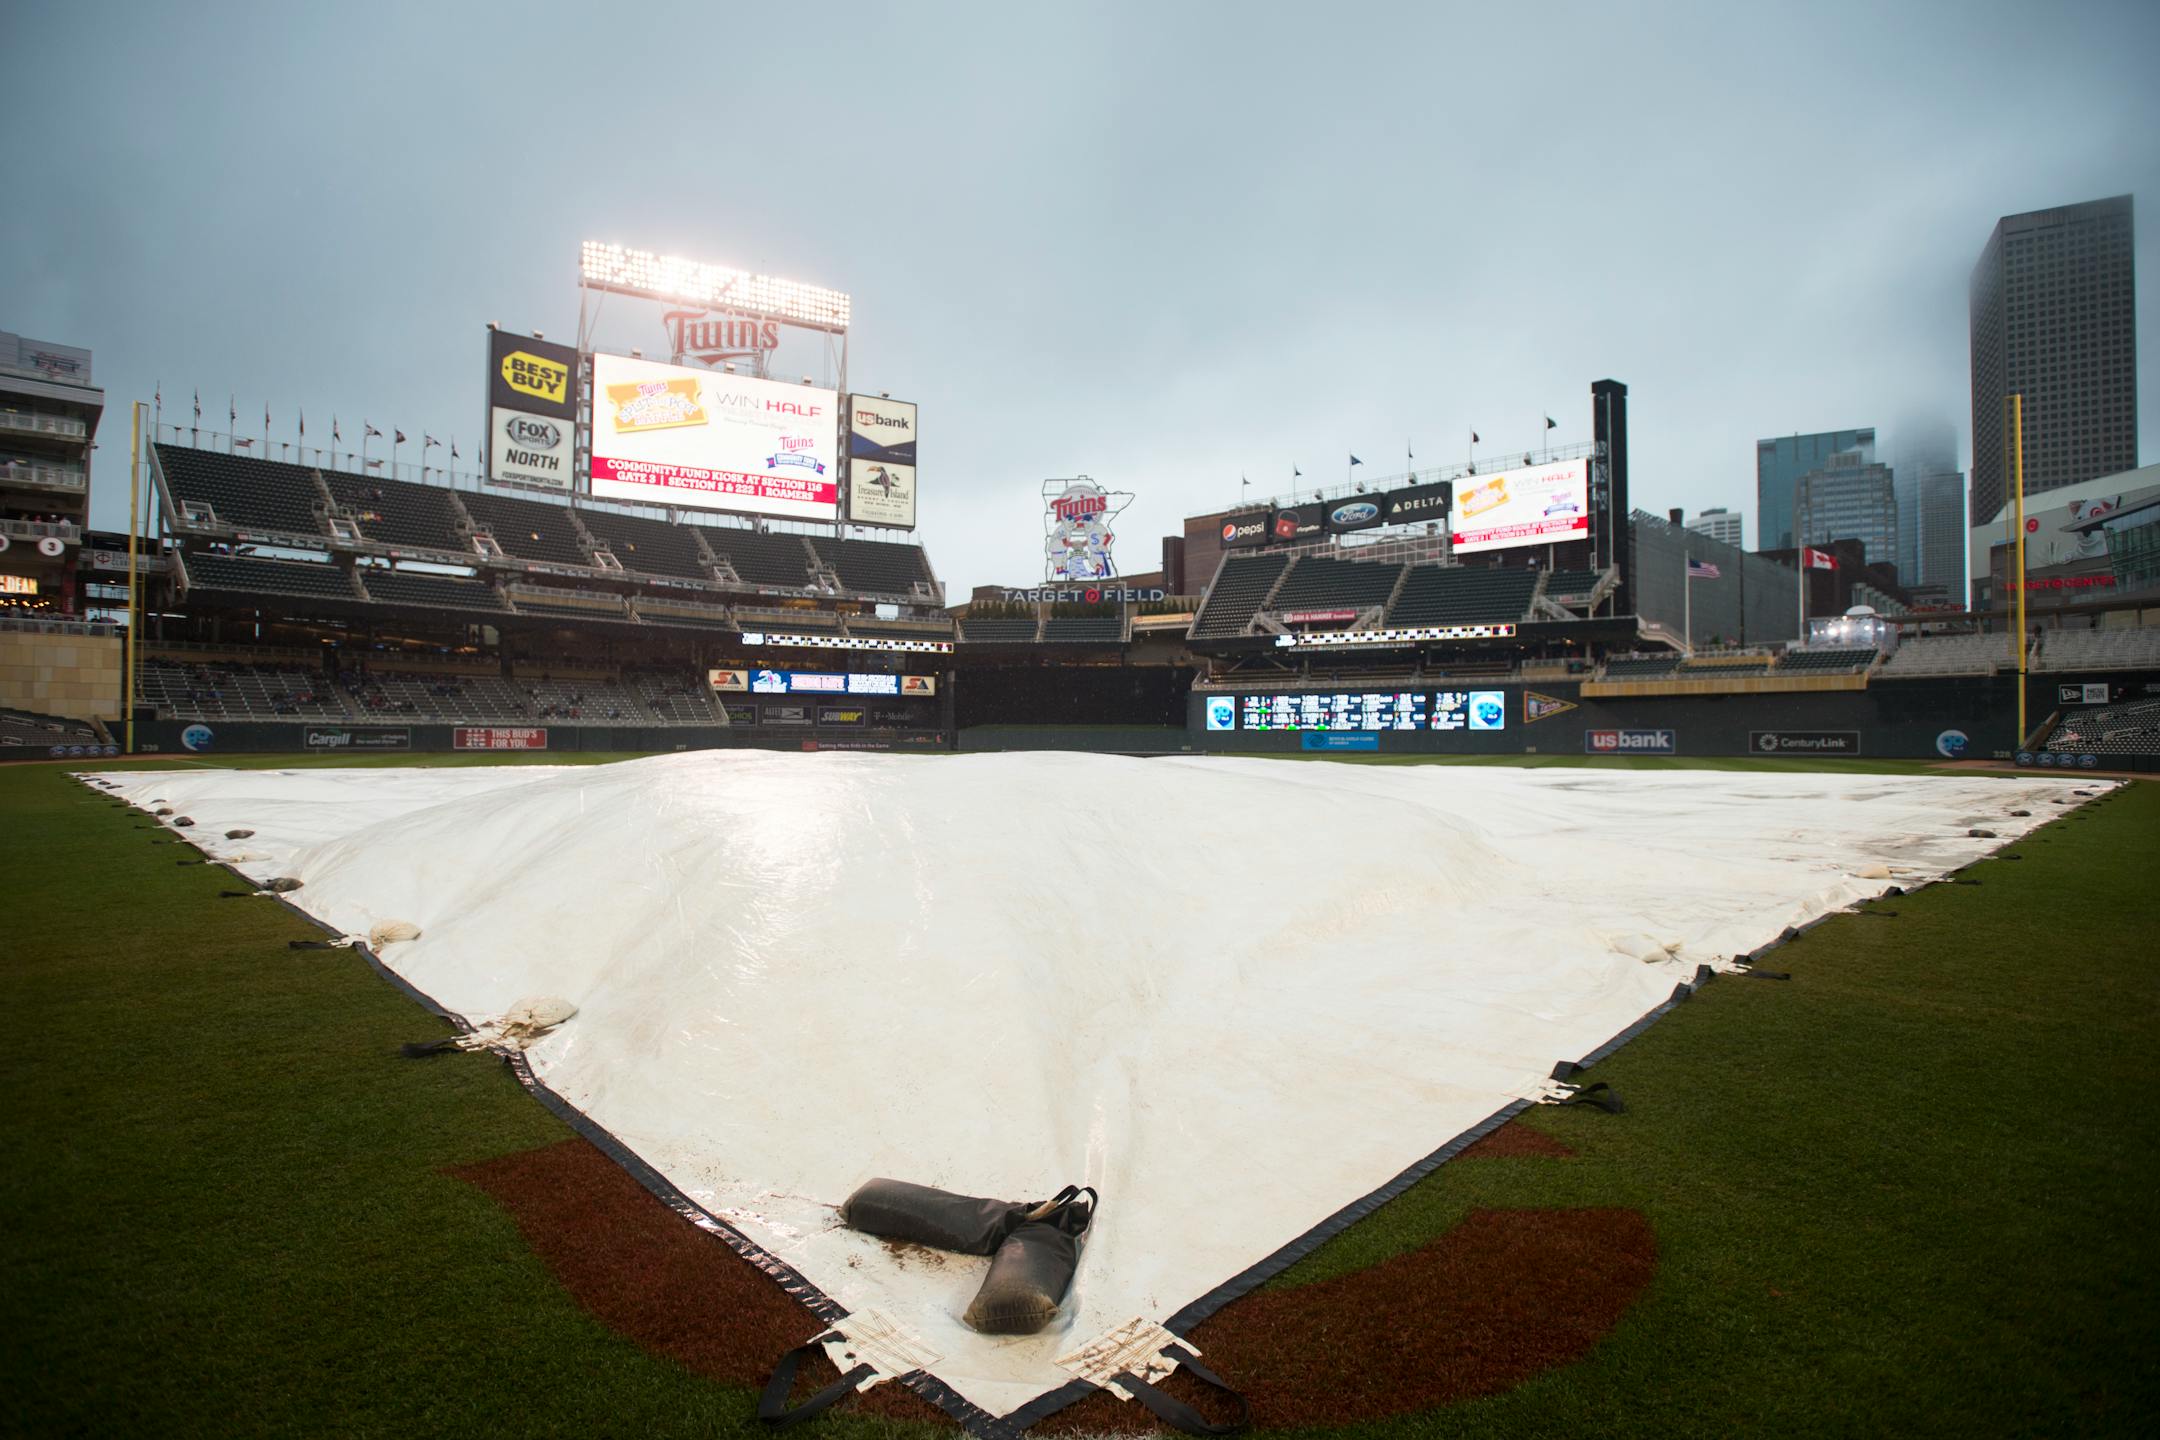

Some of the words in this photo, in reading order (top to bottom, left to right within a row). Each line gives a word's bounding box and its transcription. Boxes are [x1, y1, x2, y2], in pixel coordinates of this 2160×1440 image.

[663, 308, 779, 360] Twins
[511, 357, 566, 383] BEST
[512, 372, 560, 394] BUY
[638, 383, 667, 396] Twins
[716, 391, 759, 409] WIN
[766, 400, 822, 417] HALF
[517, 420, 550, 440] FOX
[517, 434, 551, 446] SPORTS
[778, 436, 814, 452] Twins
[506, 448, 560, 470] NORTH
[606, 459, 678, 476] COMMUNITY
[680, 467, 710, 479] FUND
[711, 471, 745, 483] KIOSK
[746, 475, 760, 485] AT
[761, 476, 806, 491] SECTION
[616, 470, 648, 483] GATE
[648, 474, 657, 484] 3
[668, 476, 717, 491] SECTION
[725, 482, 734, 492] &
[735, 484, 755, 495] 222
[765, 487, 815, 501] ROAMERS
[857, 484, 884, 497] Treasure
[890, 487, 909, 500] Island
[1050, 494, 1107, 522] Twins
[1404, 496, 1444, 511] DELTA
[1340, 510, 1369, 522] Ford
[1237, 521, 1265, 538] pepsi
[1001, 589, 1083, 603] TARGET
[1103, 588, 1165, 602] FIELD
[821, 711, 863, 722] SUBWAY
[308, 732, 352, 747] Cargill
[491, 729, 511, 738] THIS
[512, 729, 537, 739] BUD'S
[491, 738, 508, 748] FOR
[1780, 737, 1846, 749] CenturyLink
